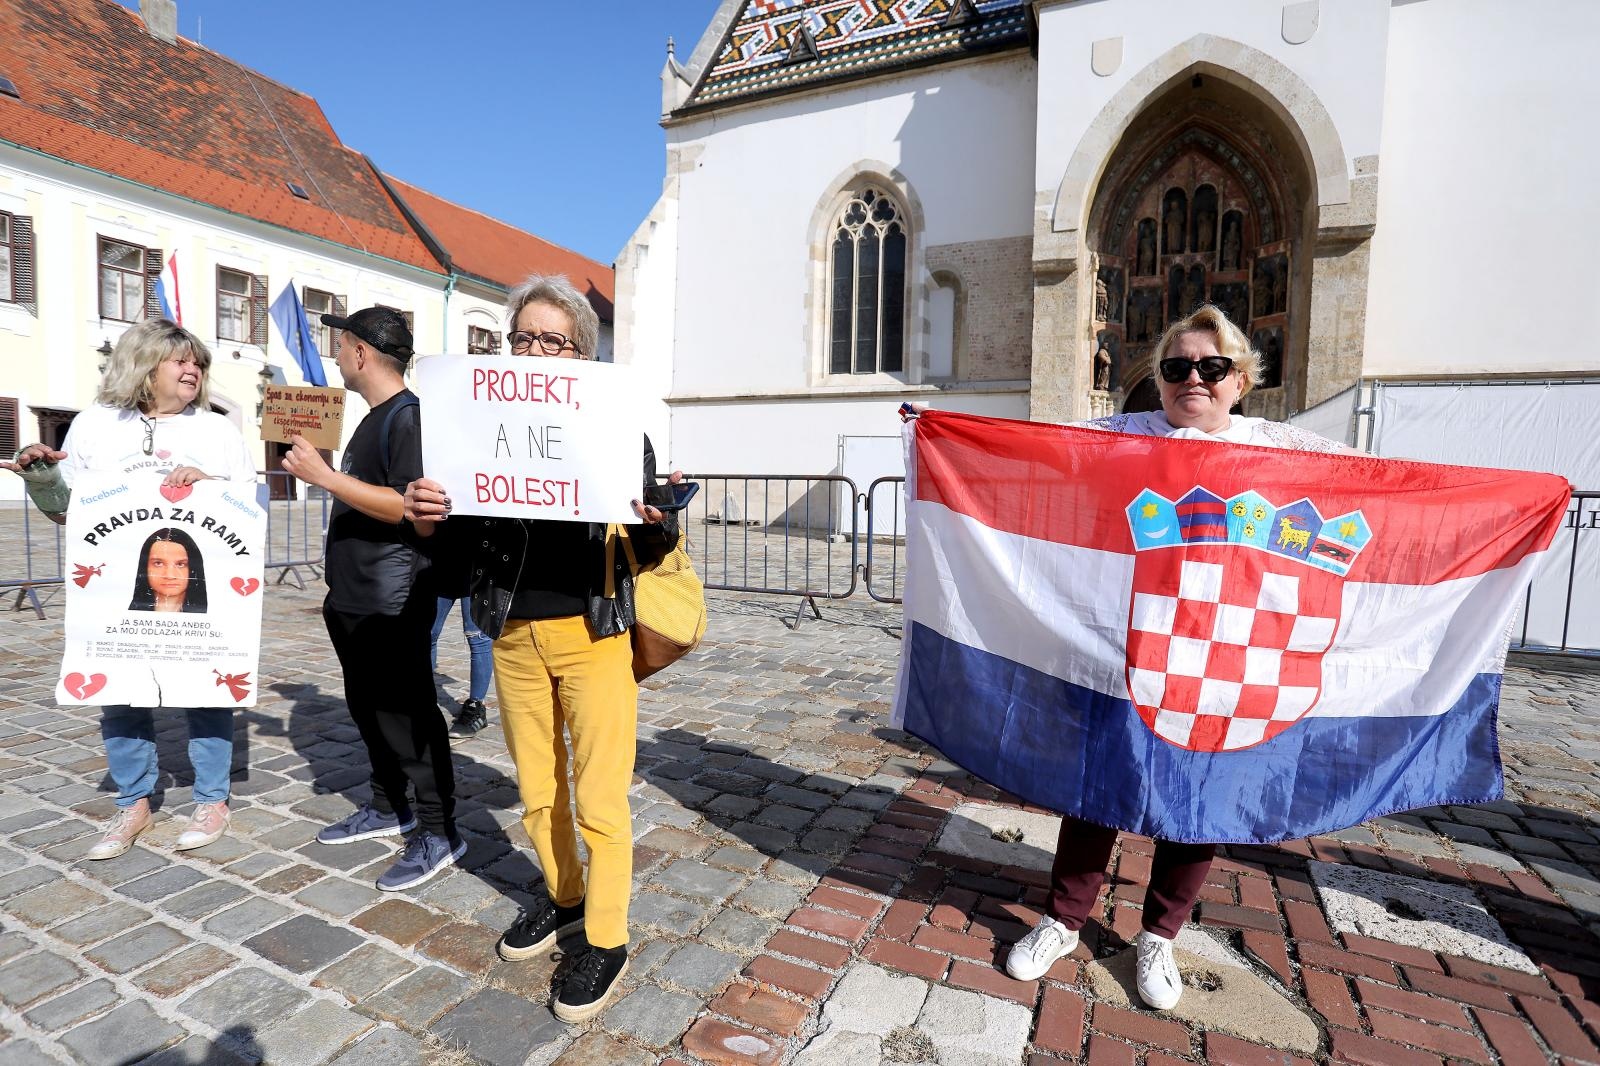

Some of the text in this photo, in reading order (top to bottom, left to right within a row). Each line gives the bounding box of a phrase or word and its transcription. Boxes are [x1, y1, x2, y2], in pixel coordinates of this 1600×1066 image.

[333, 396, 344, 405] su
[474, 368, 580, 410] PROJEKT,
[495, 423, 562, 460] A NE
[123, 460, 159, 474] RAVDA
[79, 483, 129, 506] facebook
[220, 491, 260, 520] facebook
[475, 473, 579, 516] BOLEST!
[83, 507, 250, 557] PRAVDA ZA RAMY
[105, 626, 223, 638] ZA MOJ ODLAZAK KRIVI SU:
[119, 618, 130, 627] JA
[132, 619, 153, 627] SAM
[155, 620, 178, 628] SADA
